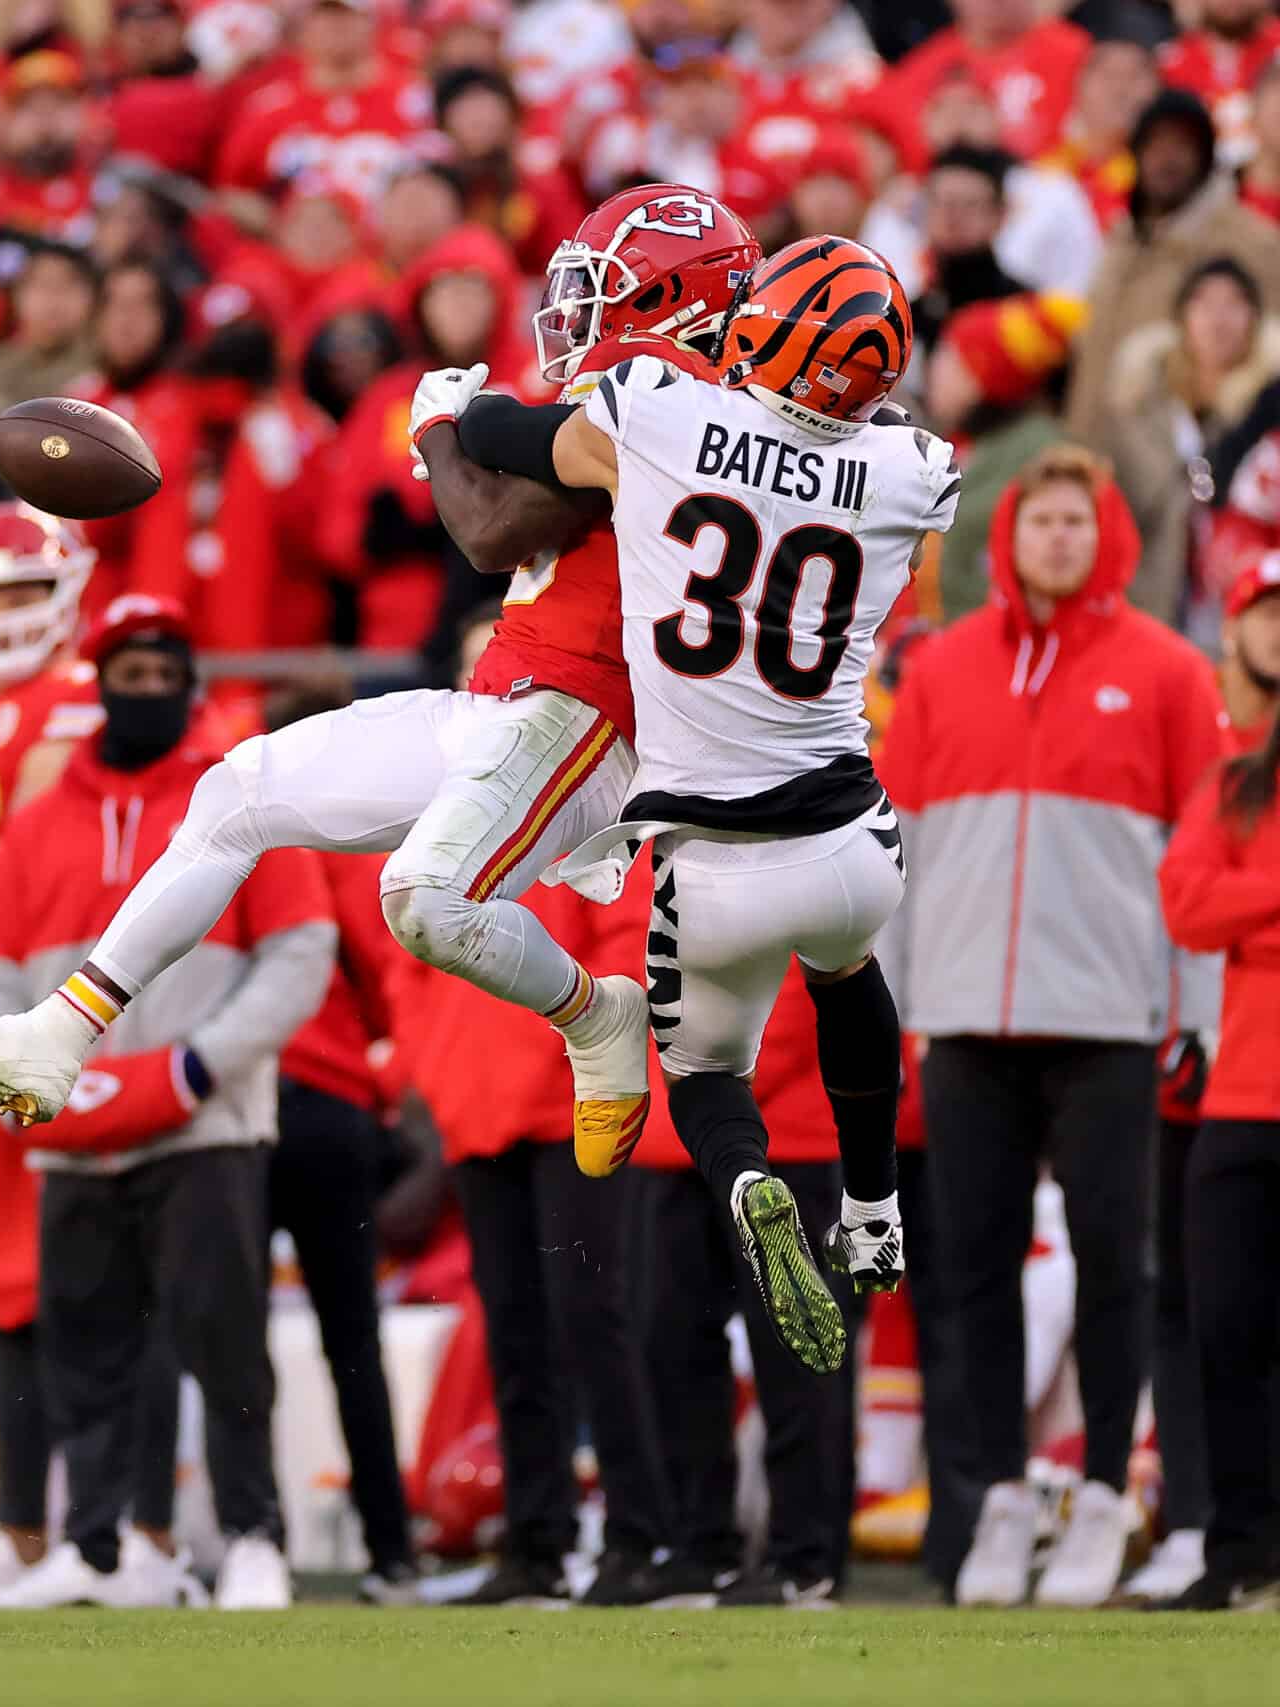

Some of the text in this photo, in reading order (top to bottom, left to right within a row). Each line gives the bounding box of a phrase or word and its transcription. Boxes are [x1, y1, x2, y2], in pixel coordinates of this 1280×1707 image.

[644, 201, 702, 227] KC
[695, 423, 868, 511] BATES III
[653, 492, 864, 701] 30
[872, 1227, 900, 1270] NIKE
